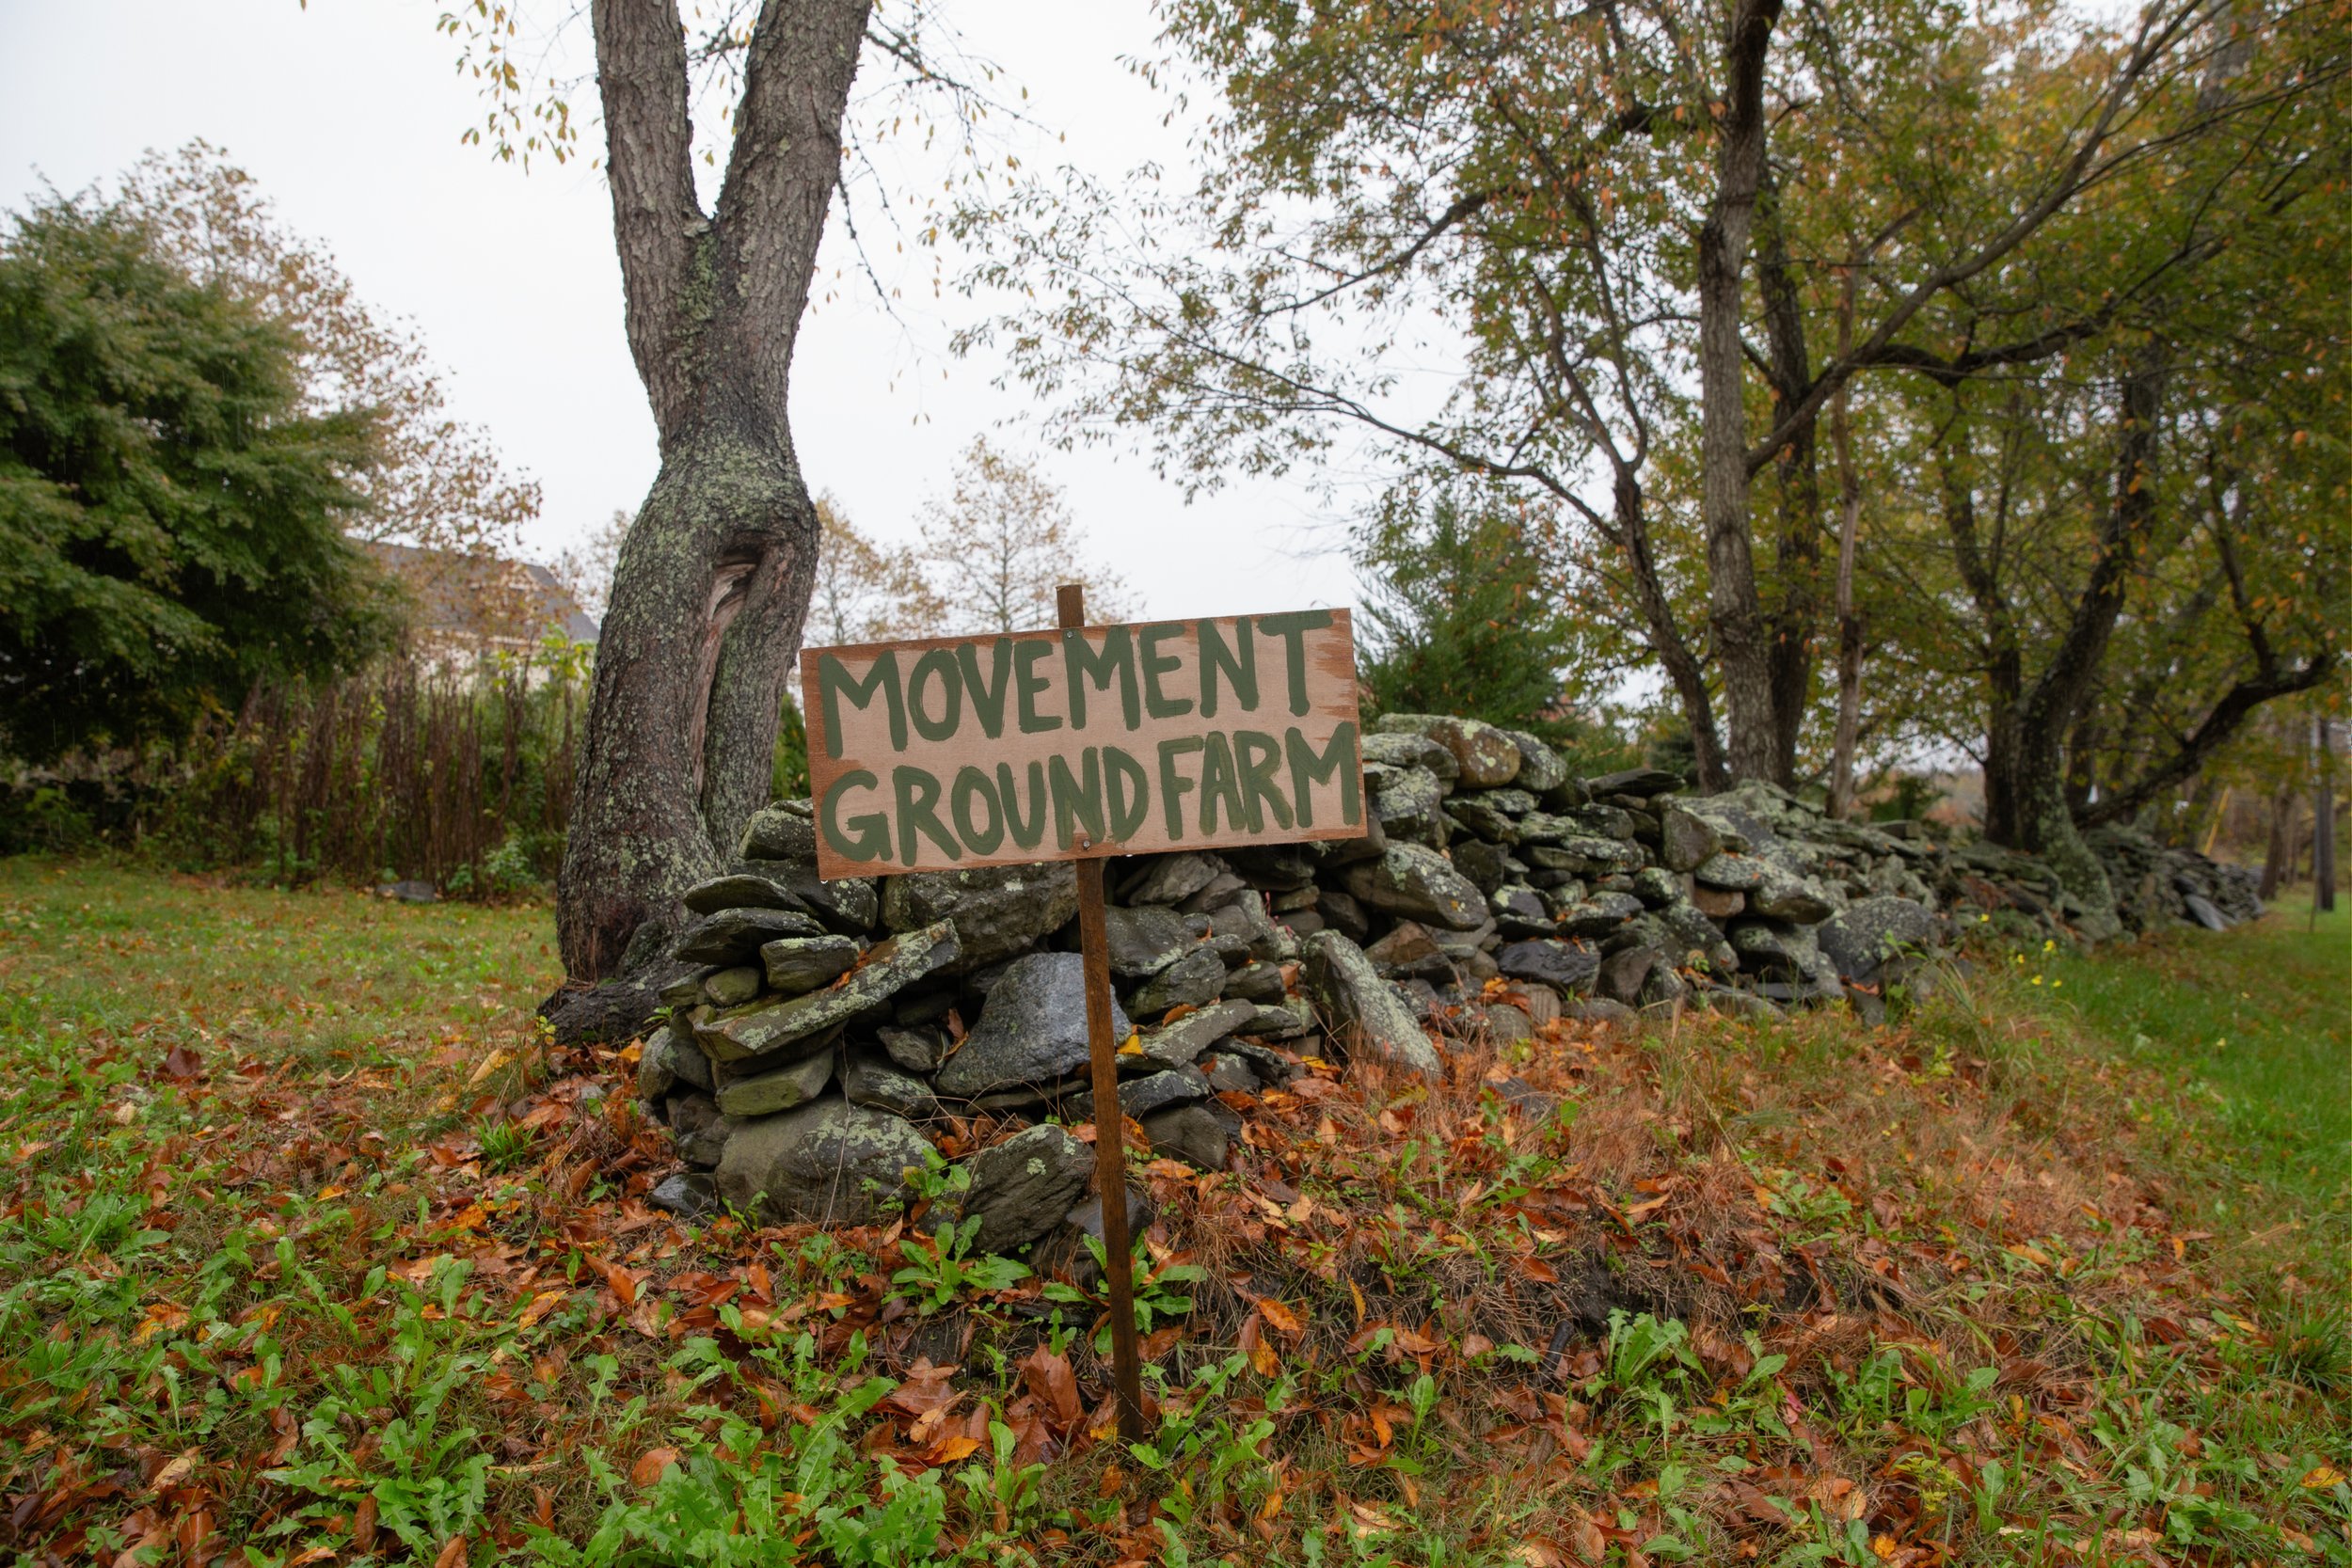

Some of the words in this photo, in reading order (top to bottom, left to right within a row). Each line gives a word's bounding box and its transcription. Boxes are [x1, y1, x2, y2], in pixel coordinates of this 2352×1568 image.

[818, 610, 1333, 759] MOVEMENT
[820, 746, 1150, 866] GROUND
[1157, 721, 1360, 841] FARM
